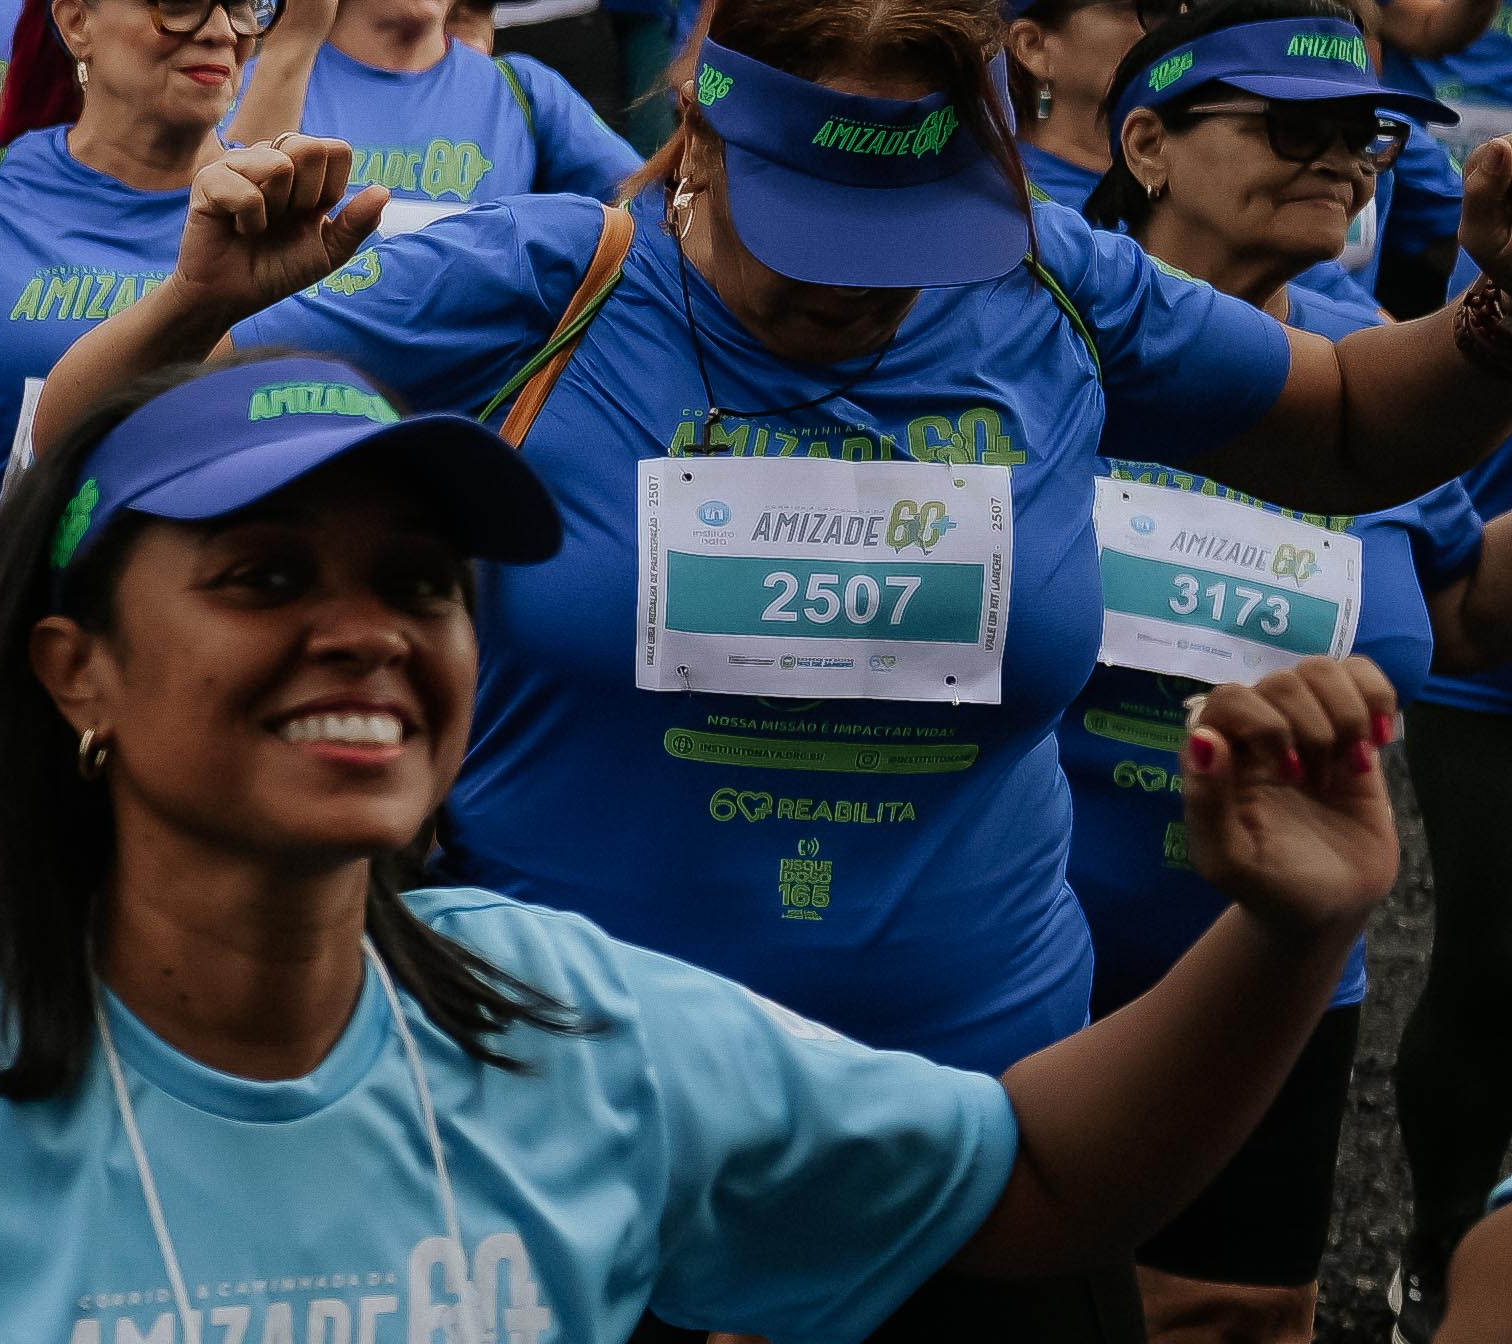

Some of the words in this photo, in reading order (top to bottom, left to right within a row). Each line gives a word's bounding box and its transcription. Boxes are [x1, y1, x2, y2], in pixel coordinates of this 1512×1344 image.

[812, 119, 917, 156] AMIZADE
[648, 475, 660, 508] 2507
[751, 511, 885, 547] AMIZADE
[885, 499, 957, 556] 60+
[990, 497, 1003, 532] 2507
[1169, 531, 1271, 572] AMIZADE
[760, 570, 924, 626] 2507
[1168, 573, 1292, 637] 3173
[707, 714, 758, 729] NOSSA
[761, 720, 818, 733] MISSÃO
[833, 722, 912, 738] IMPACTAR
[777, 798, 917, 824] REABILITA
[778, 883, 830, 908] 165
